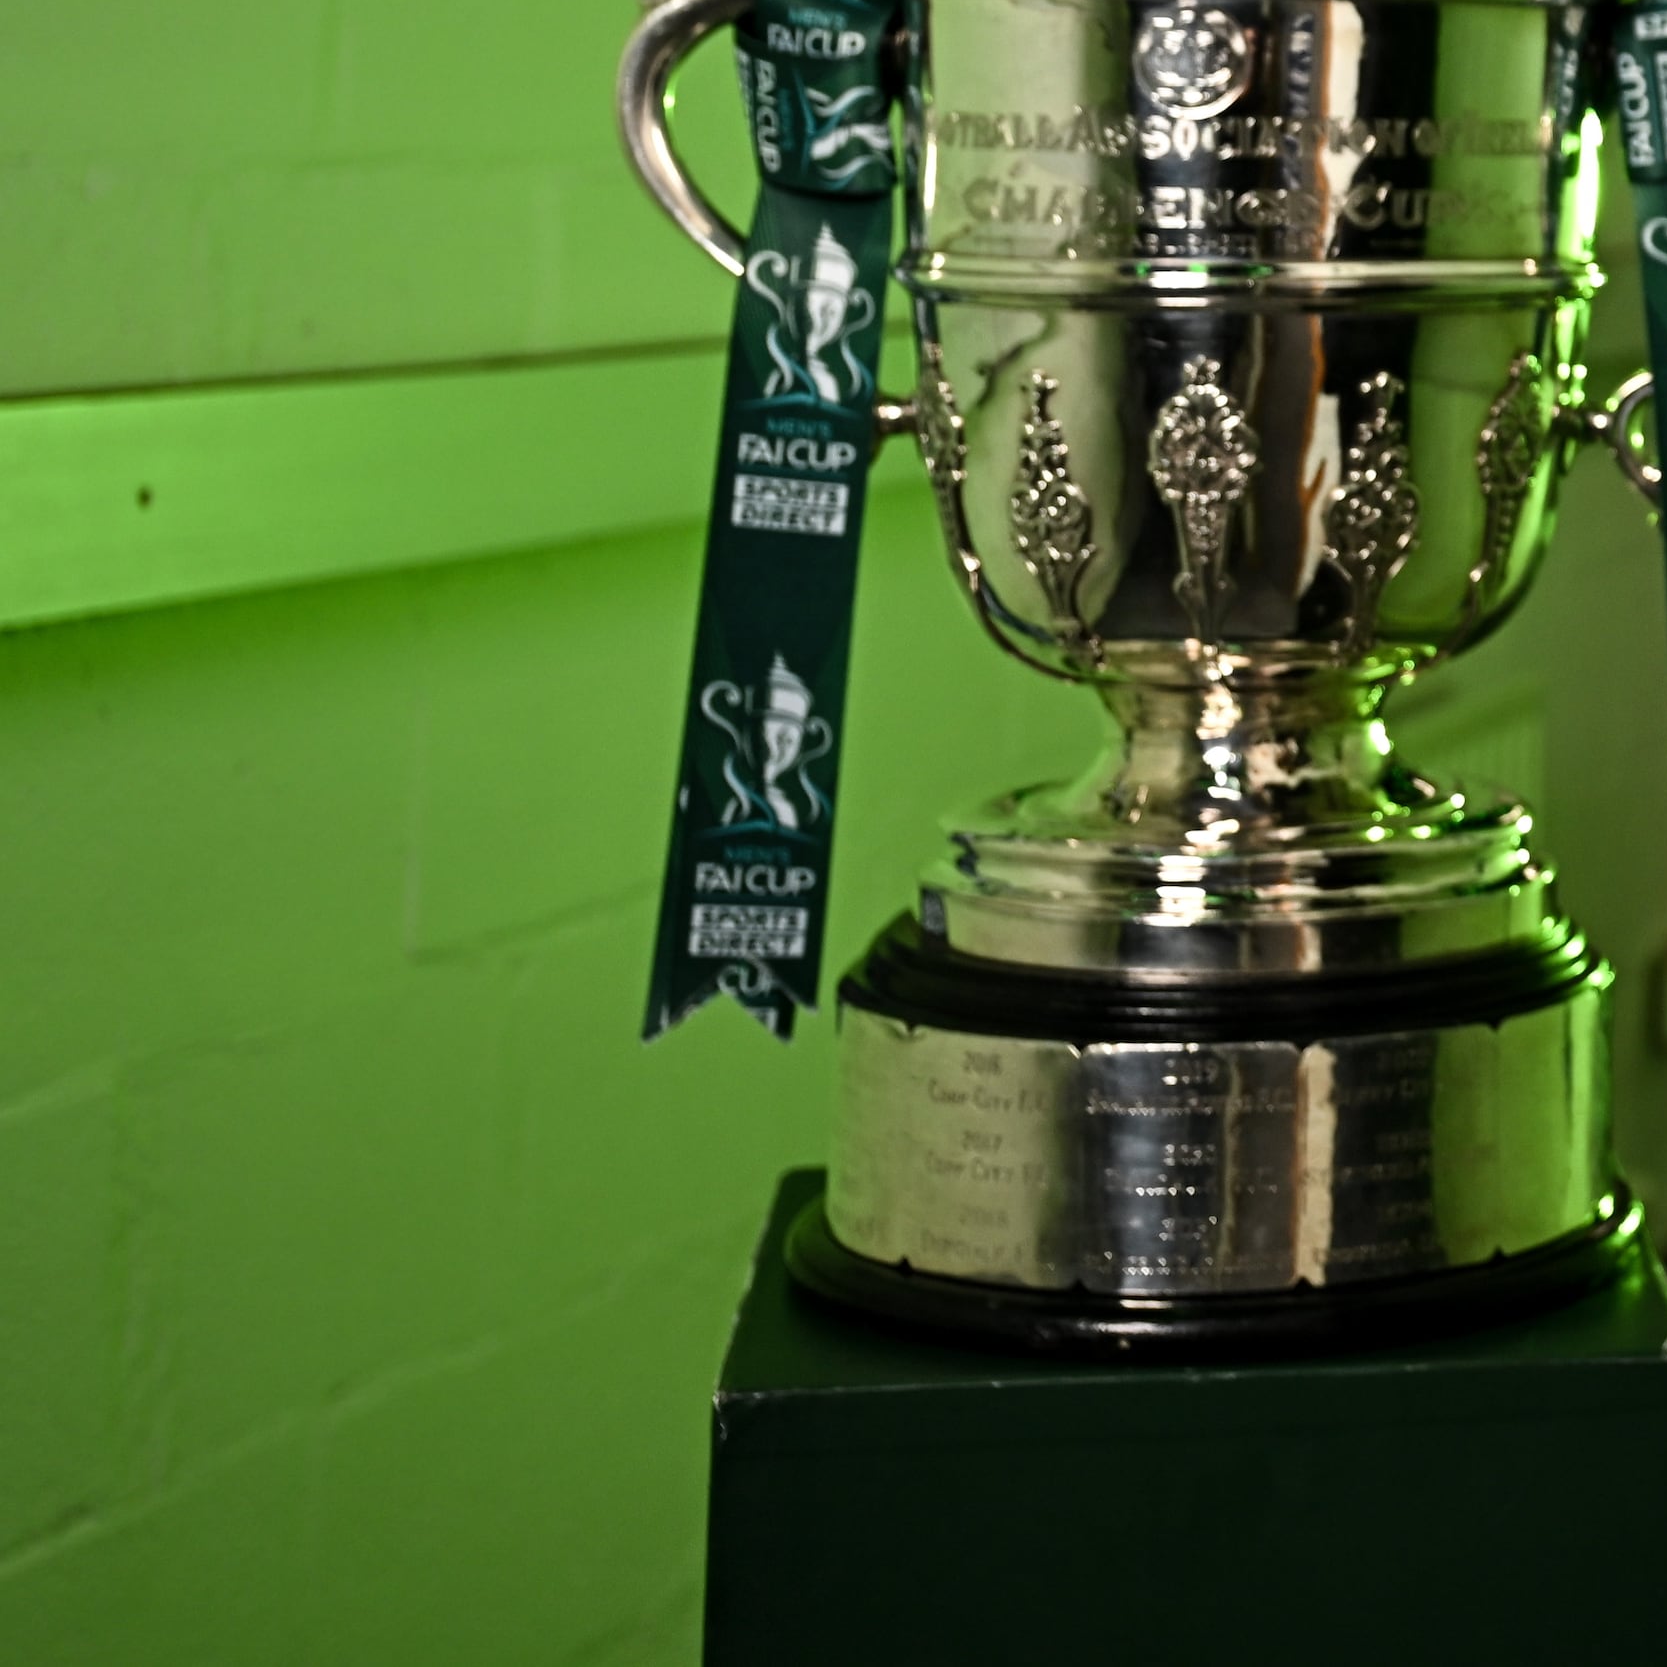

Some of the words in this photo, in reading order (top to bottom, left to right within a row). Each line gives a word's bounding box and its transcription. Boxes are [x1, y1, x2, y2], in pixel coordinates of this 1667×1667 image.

[766, 22, 803, 55] FAI
[805, 27, 866, 60] CUP
[1617, 52, 1650, 119] CUP
[1625, 120, 1655, 167] FAI
[738, 432, 784, 466] FAI
[786, 437, 857, 472] CUP
[743, 477, 840, 506] SPORTS
[740, 501, 835, 531] DIRECT
[695, 862, 743, 893] FAI
[745, 864, 817, 896] CUP
